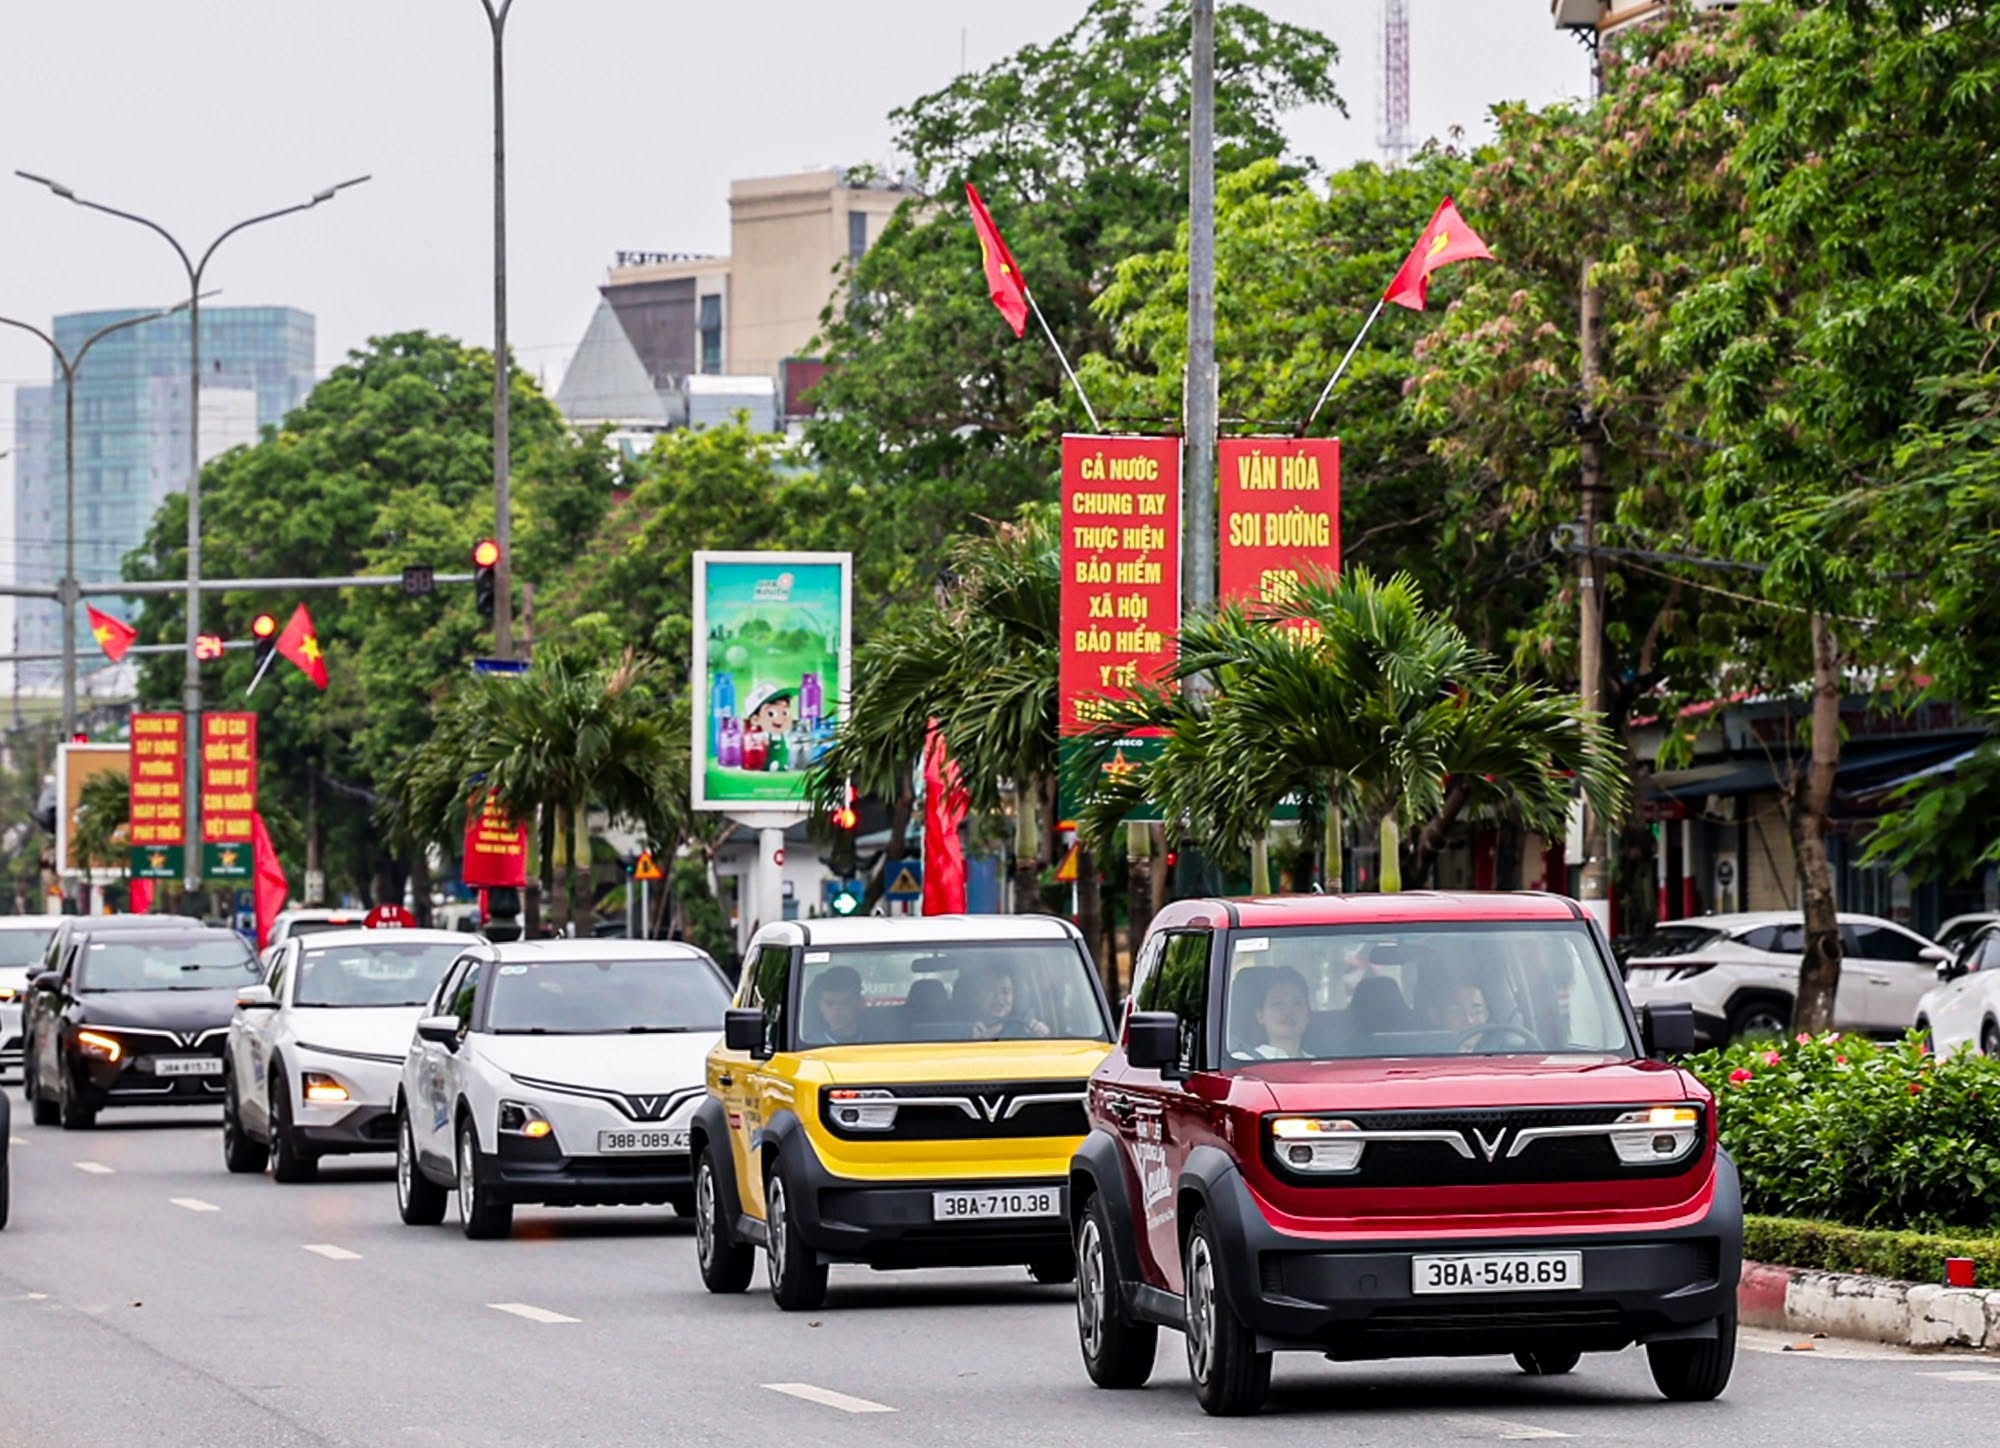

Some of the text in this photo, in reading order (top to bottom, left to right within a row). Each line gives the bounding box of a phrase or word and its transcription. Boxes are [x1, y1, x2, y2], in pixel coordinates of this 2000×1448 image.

[1081, 451, 1158, 481] CẢ NƯỚC
[1238, 449, 1320, 490] VĂN HÓA
[1072, 492, 1166, 515] CHUNG TAY
[1073, 523, 1165, 554] THỰC HIỆN
[1229, 504, 1330, 547] SOI ĐƯỜNG
[1075, 554, 1161, 584] BẢO HIỂM
[1089, 592, 1148, 623] XÃ HỘI
[195, 635, 221, 659] 24
[1075, 623, 1162, 654] BẢO HIỂM
[1100, 659, 1138, 688] Y TẾ
[944, 1194, 1050, 1216] 38A-710.38
[1427, 1260, 1568, 1287] 38A-548.69
